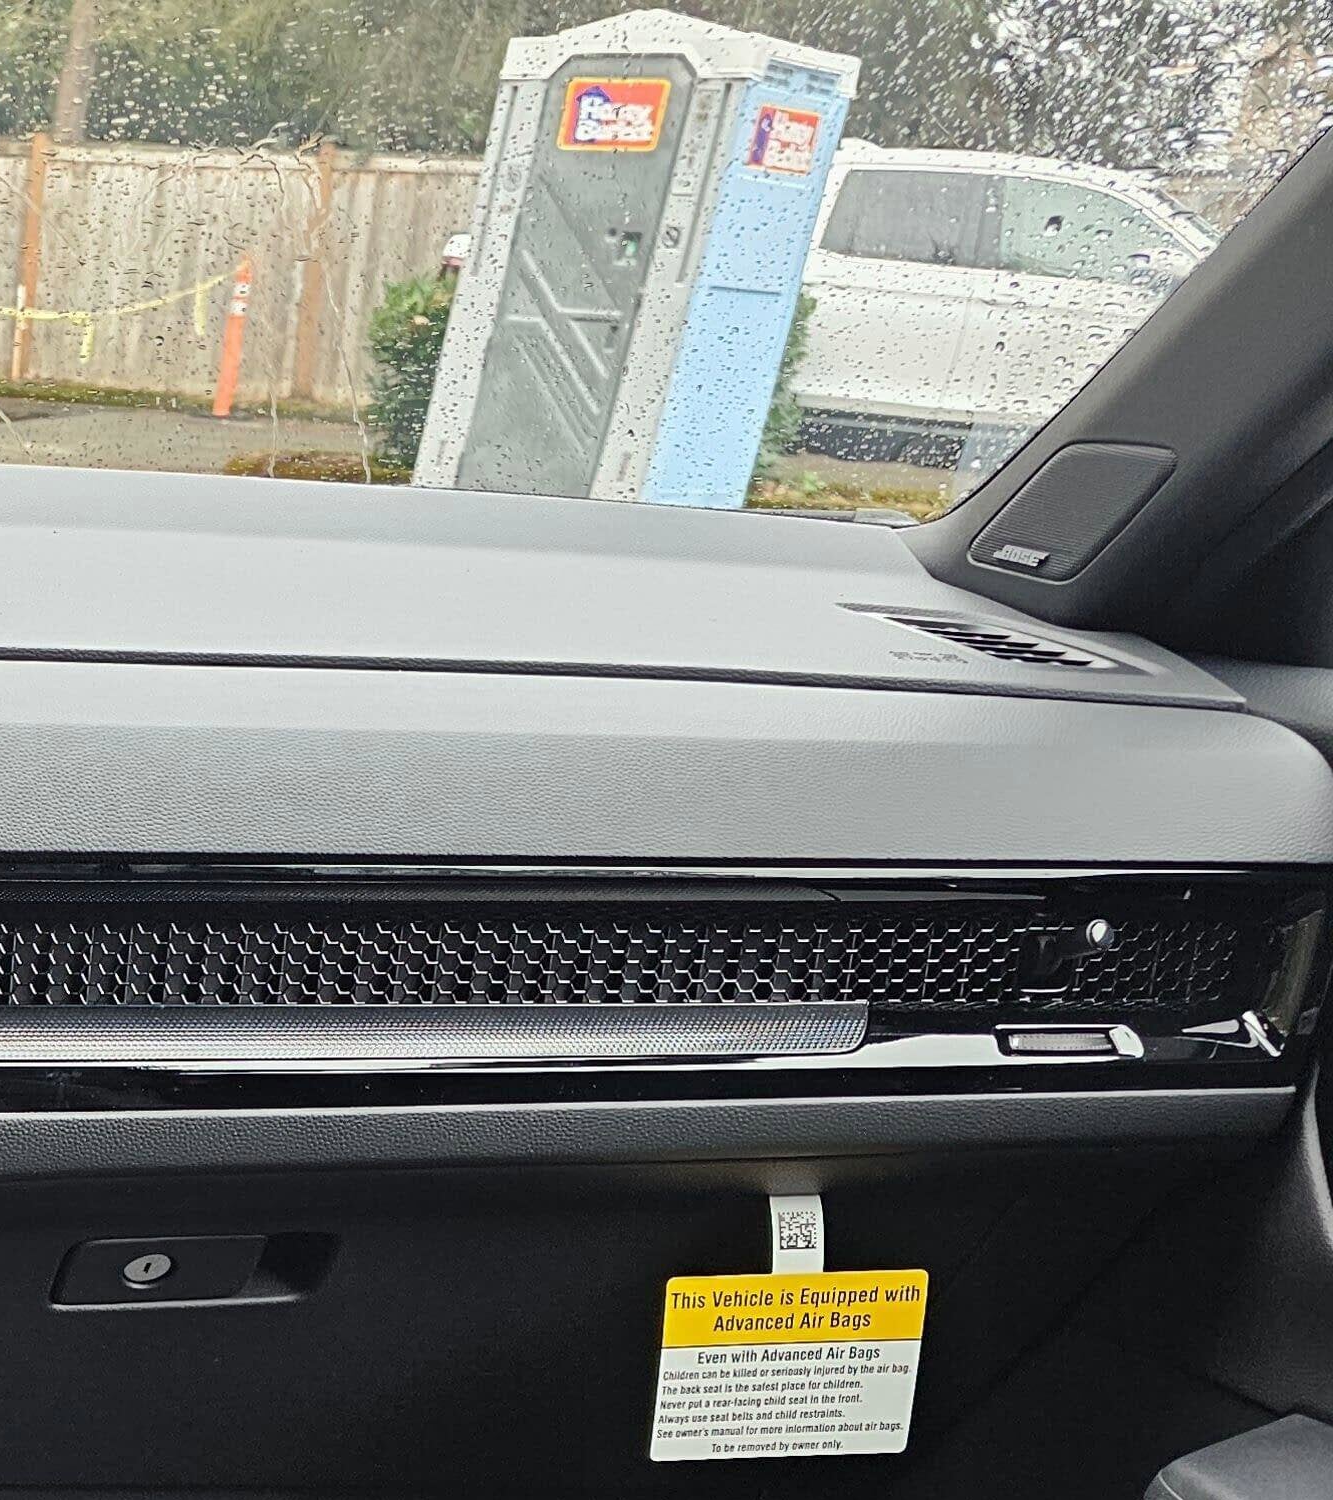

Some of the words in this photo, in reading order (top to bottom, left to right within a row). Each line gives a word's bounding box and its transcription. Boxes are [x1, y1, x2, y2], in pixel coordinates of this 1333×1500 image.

[671, 1292, 706, 1309] This
[713, 1290, 774, 1308] Vehicle
[779, 1289, 793, 1305] is
[800, 1287, 879, 1307] Equipped
[884, 1286, 921, 1302] with
[713, 1312, 795, 1332] Advanced
[799, 1311, 824, 1329] Air
[829, 1310, 872, 1330] Bags
[697, 1352, 727, 1364] Even
[731, 1350, 758, 1363] with
[761, 1347, 823, 1362] Advanced
[826, 1347, 845, 1360] Air
[848, 1346, 881, 1361] Bags
[663, 1370, 700, 1381] Children
[702, 1370, 718, 1380] can
[719, 1369, 730, 1379] be
[732, 1368, 758, 1378] killed
[759, 1368, 769, 1377] or
[771, 1366, 811, 1377] seriously
[813, 1365, 846, 1377] injured
[847, 1365, 858, 1376] by
[860, 1364, 874, 1374] the
[876, 1364, 890, 1374] air
[891, 1363, 912, 1374] bag.
[662, 1386, 678, 1396] The
[680, 1385, 701, 1395] back
[703, 1384, 723, 1394] seat
[724, 1384, 733, 1393] is
[734, 1383, 750, 1393] the
[751, 1381, 779, 1392] safest
[780, 1381, 806, 1392] place
[808, 1380, 821, 1390] for
[823, 1379, 864, 1390] children.
[660, 1400, 686, 1410] Never
[688, 1400, 703, 1410] put
[704, 1400, 711, 1409] a
[712, 1397, 761, 1409] rear-facing
[764, 1395, 787, 1406] child
[788, 1395, 808, 1405] seat
[810, 1395, 820, 1404] in
[821, 1394, 836, 1404] the
[837, 1393, 863, 1404] front.
[658, 1415, 690, 1425] Always
[691, 1414, 708, 1423] use
[709, 1412, 730, 1423] seat
[732, 1411, 753, 1421] belts
[755, 1411, 773, 1420] and
[775, 1409, 797, 1420] child
[799, 1408, 846, 1419] restraints.
[656, 1429, 673, 1439] See
[675, 1428, 710, 1438] owner's
[711, 1426, 744, 1437] manual
[745, 1426, 759, 1436] for
[760, 1425, 783, 1435] more
[785, 1423, 836, 1434] information
[837, 1422, 863, 1432] about
[864, 1422, 878, 1432] air
[878, 1421, 904, 1433] bags.
[712, 1443, 722, 1453] To
[724, 1443, 735, 1453] be
[737, 1442, 776, 1453] removed
[778, 1441, 790, 1453] by
[791, 1441, 820, 1450] owner
[822, 1440, 844, 1451] only.
